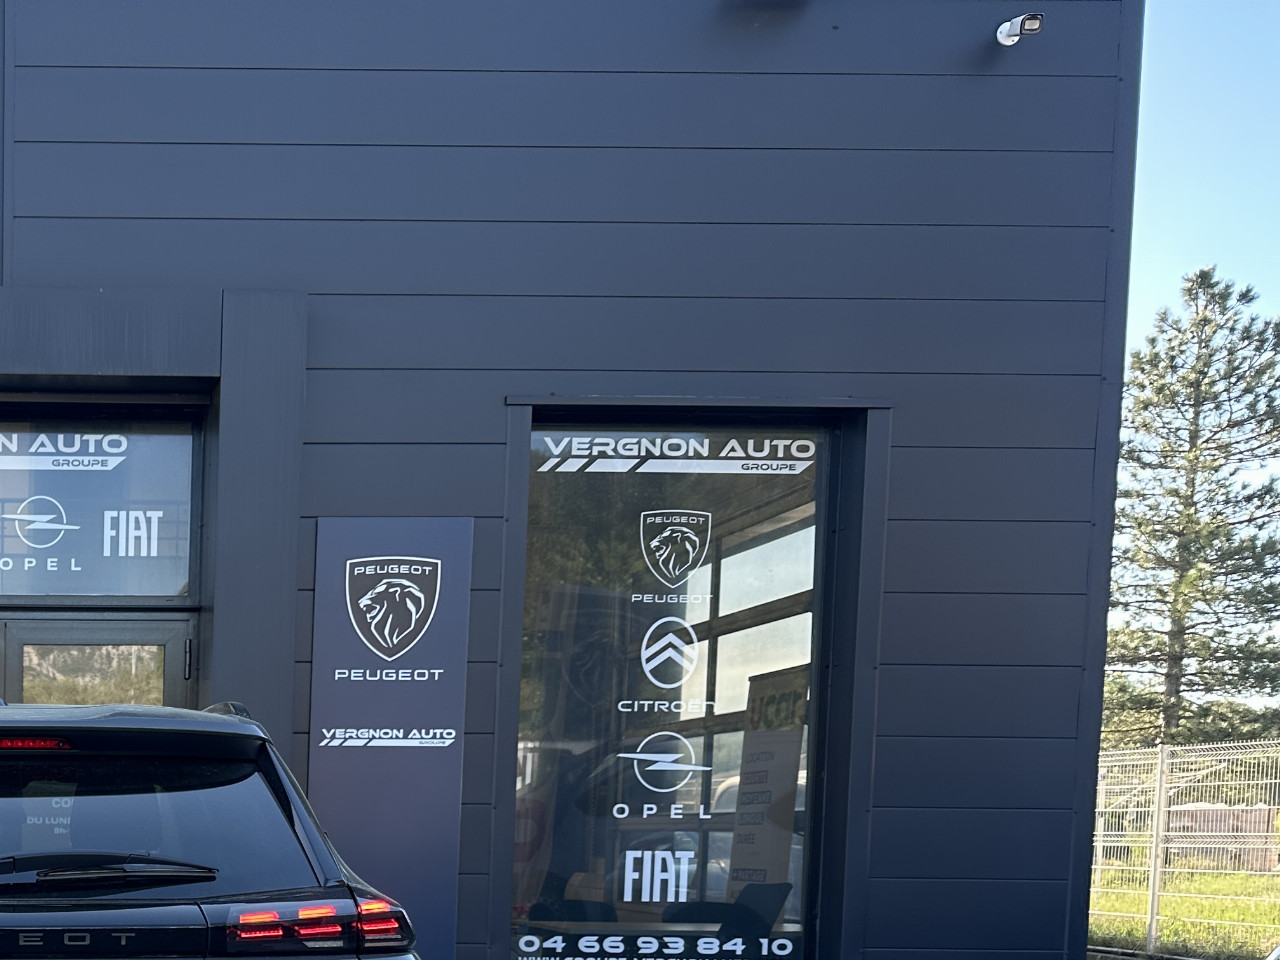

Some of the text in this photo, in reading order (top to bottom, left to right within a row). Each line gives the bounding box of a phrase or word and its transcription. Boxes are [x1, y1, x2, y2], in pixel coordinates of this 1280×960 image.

[28, 433, 128, 453] AUTO
[543, 437, 816, 458] VERGNON AUTO
[51, 458, 109, 467] GROUPE
[740, 463, 797, 471] GROUPE
[646, 516, 705, 524] PEUGEOT
[103, 510, 163, 557] FIAT
[0, 557, 82, 571] OPEL
[354, 565, 433, 575] PEUGEOT
[631, 594, 713, 603] PEUGEOT
[334, 669, 444, 681] PEUGEOT
[617, 700, 716, 713] CITROËN
[322, 728, 456, 739] VERGNON AUTO
[612, 804, 712, 819] OPEL
[27, 816, 42, 824] DU
[623, 850, 695, 902] FIAT
[518, 935, 793, 956] 04 66 93 84 10
